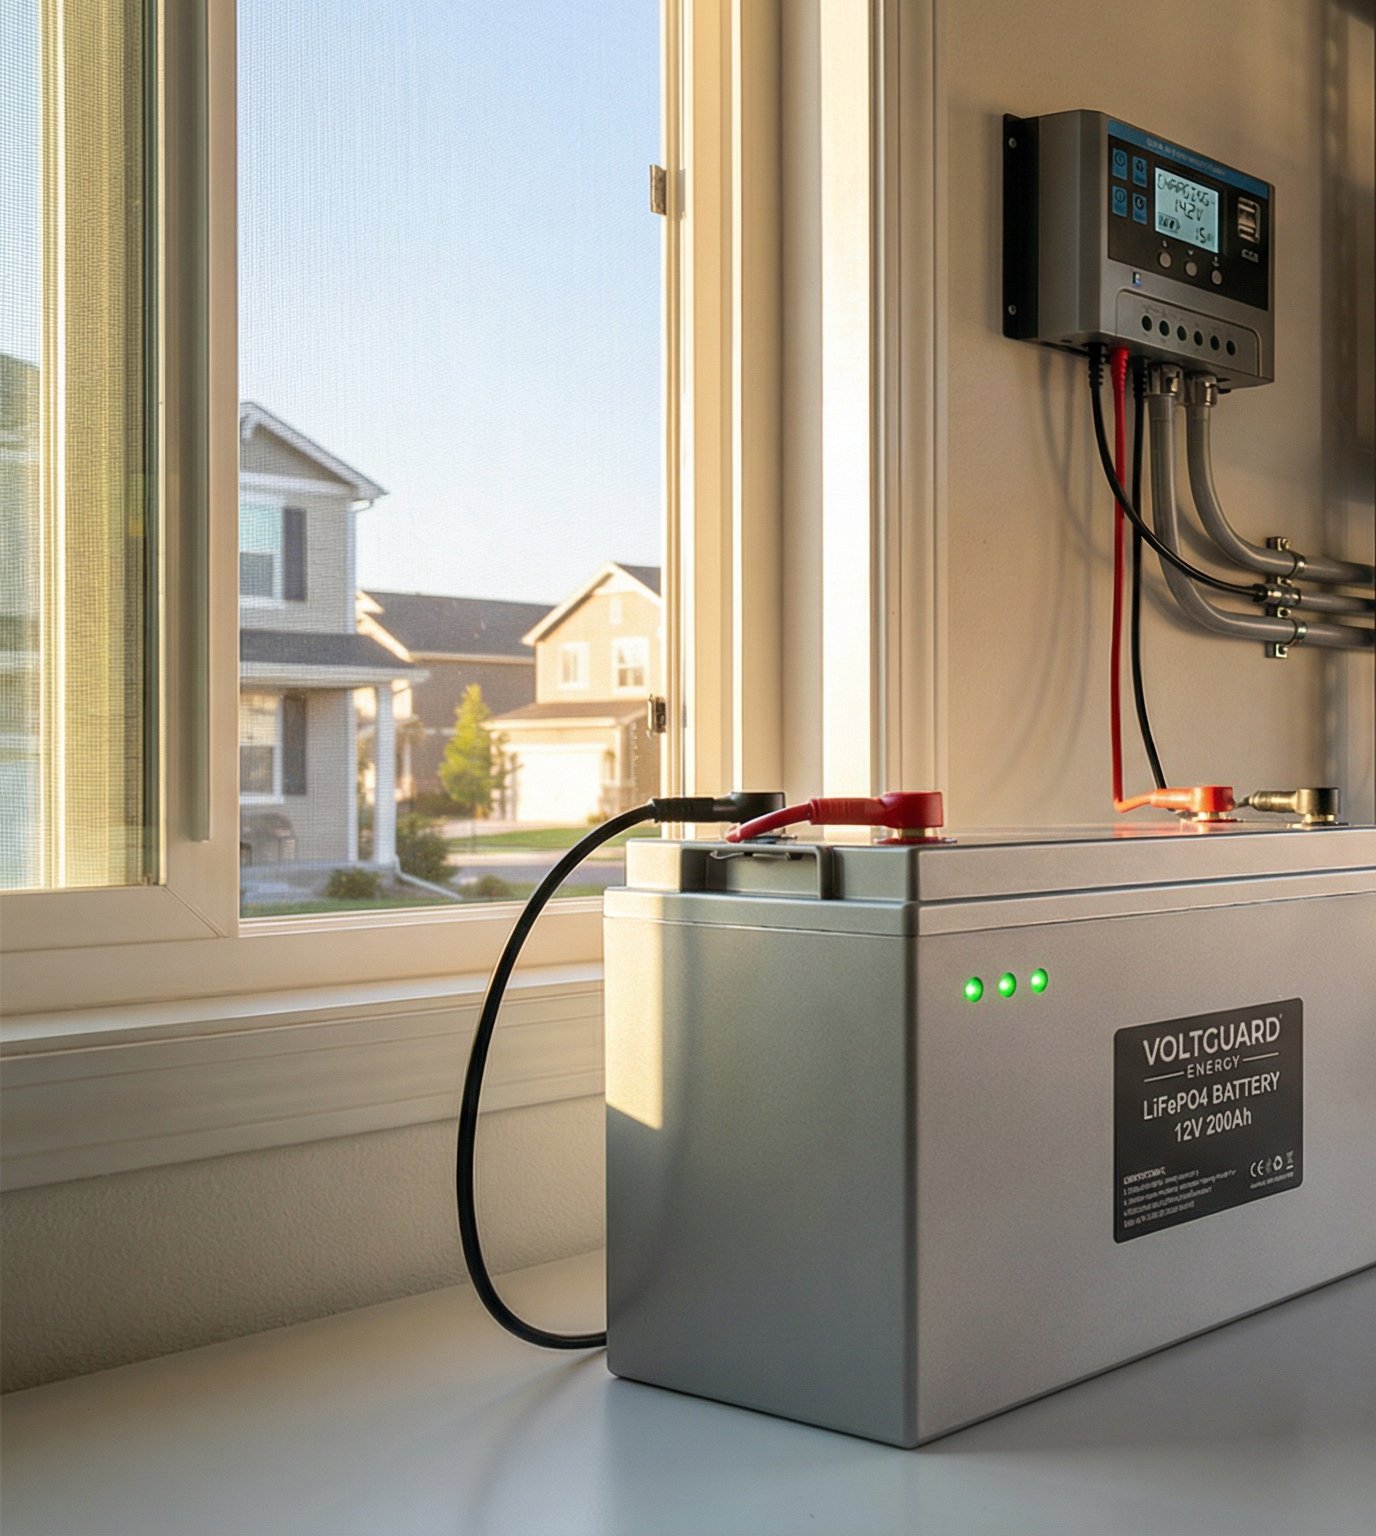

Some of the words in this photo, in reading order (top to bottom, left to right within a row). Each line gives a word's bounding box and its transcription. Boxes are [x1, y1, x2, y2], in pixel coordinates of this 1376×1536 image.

[1143, 1016, 1281, 1066] VOLTGUARD
[1187, 1055, 1240, 1079] ENERGY
[1143, 1086, 1209, 1120] LiFePO4
[1212, 1071, 1281, 1105] BATTERY
[1174, 1116, 1204, 1143] 12V
[1206, 1107, 1252, 1136] 200Ah
